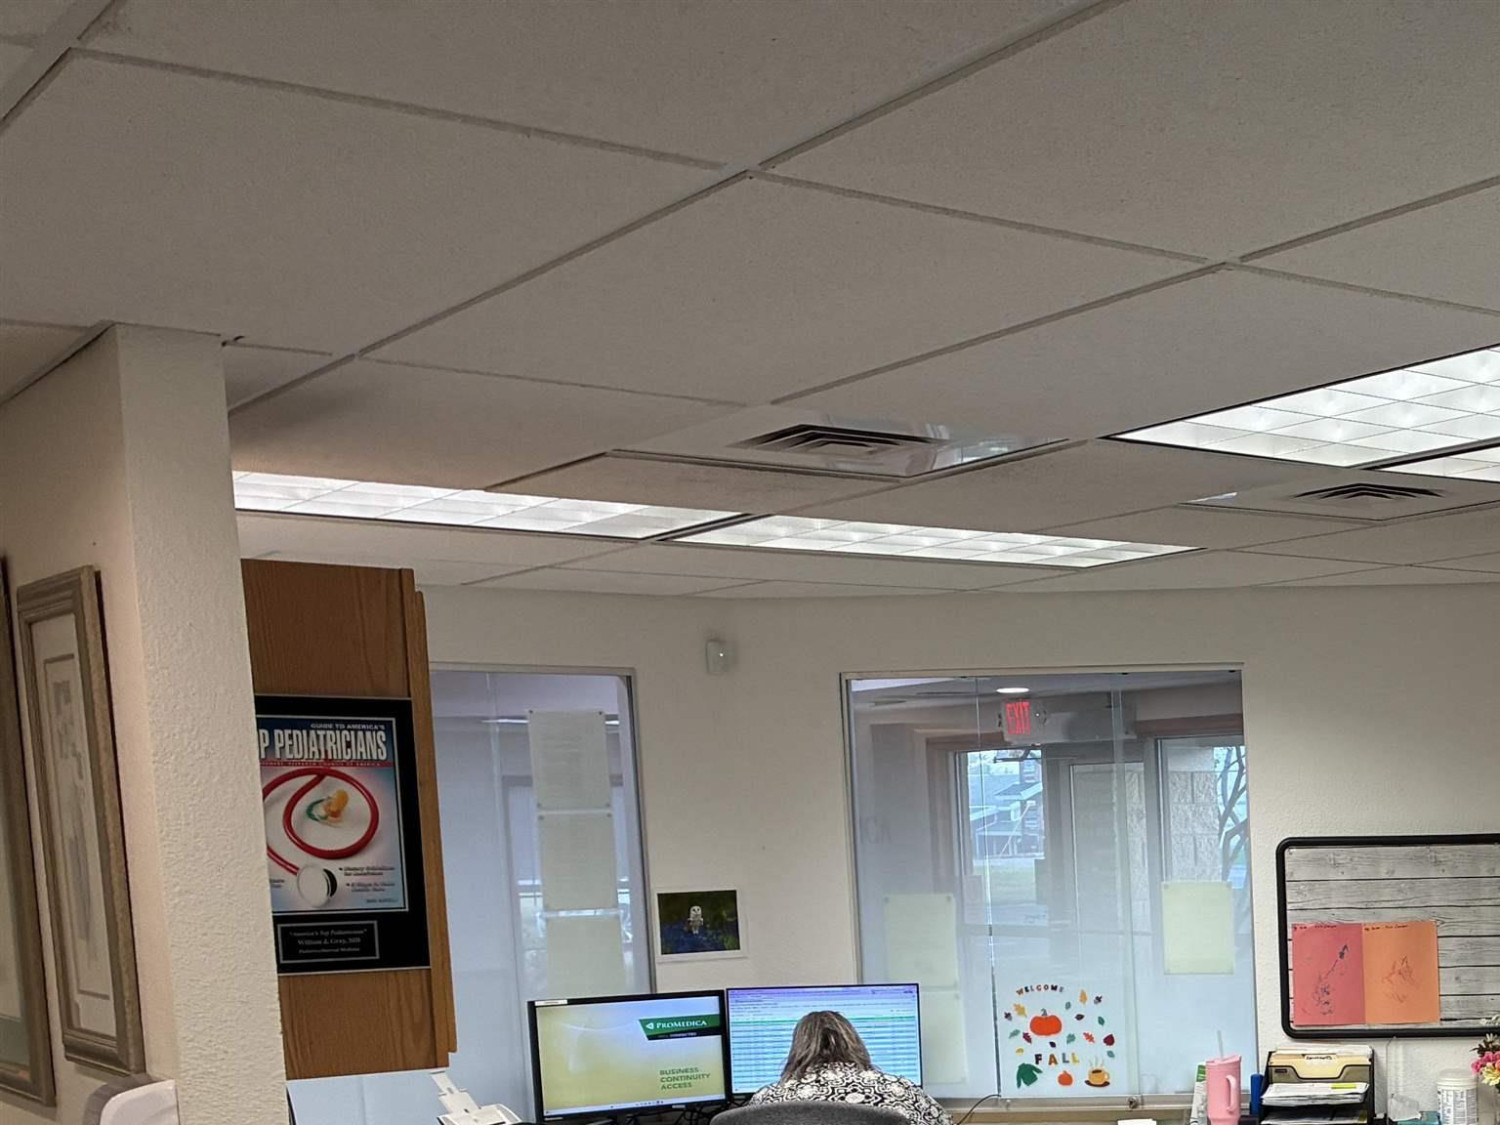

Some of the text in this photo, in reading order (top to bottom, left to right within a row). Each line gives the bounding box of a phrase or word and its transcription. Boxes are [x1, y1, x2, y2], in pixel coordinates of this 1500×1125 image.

[1005, 701, 1031, 735] EXIT
[273, 729, 387, 760] PEDIATRICIANS
[1016, 984, 1064, 995] WELCOME
[1034, 1052, 1080, 1065] FALL
[659, 1067, 699, 1075] BUSINESS
[660, 1073, 711, 1083] CONTINUITY
[661, 1082, 693, 1090] ACCESS
